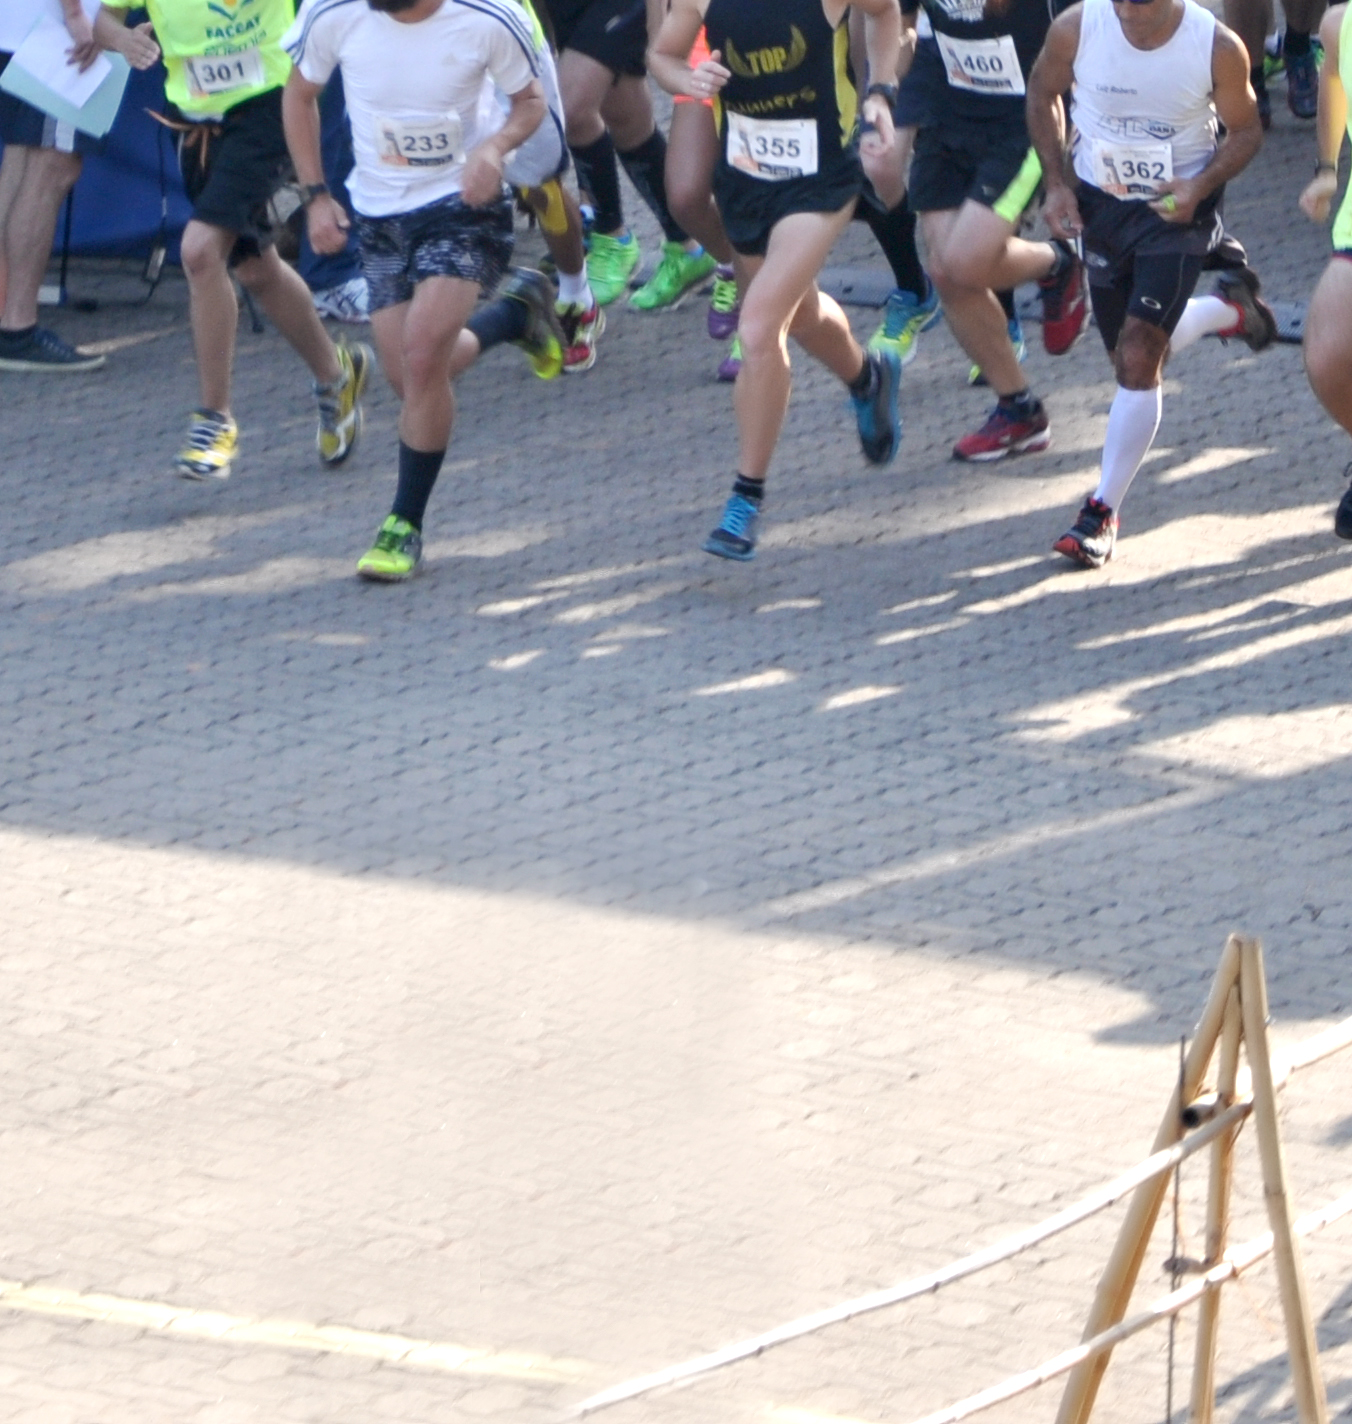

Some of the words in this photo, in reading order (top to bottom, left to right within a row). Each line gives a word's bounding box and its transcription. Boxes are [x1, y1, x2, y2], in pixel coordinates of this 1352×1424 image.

[205, 12, 262, 39] FACCAT
[202, 59, 245, 83] 301
[745, 46, 787, 75] TOP
[964, 54, 1003, 73] 460
[403, 133, 449, 152] 233
[755, 136, 801, 158] 355
[1122, 160, 1166, 182] 362
